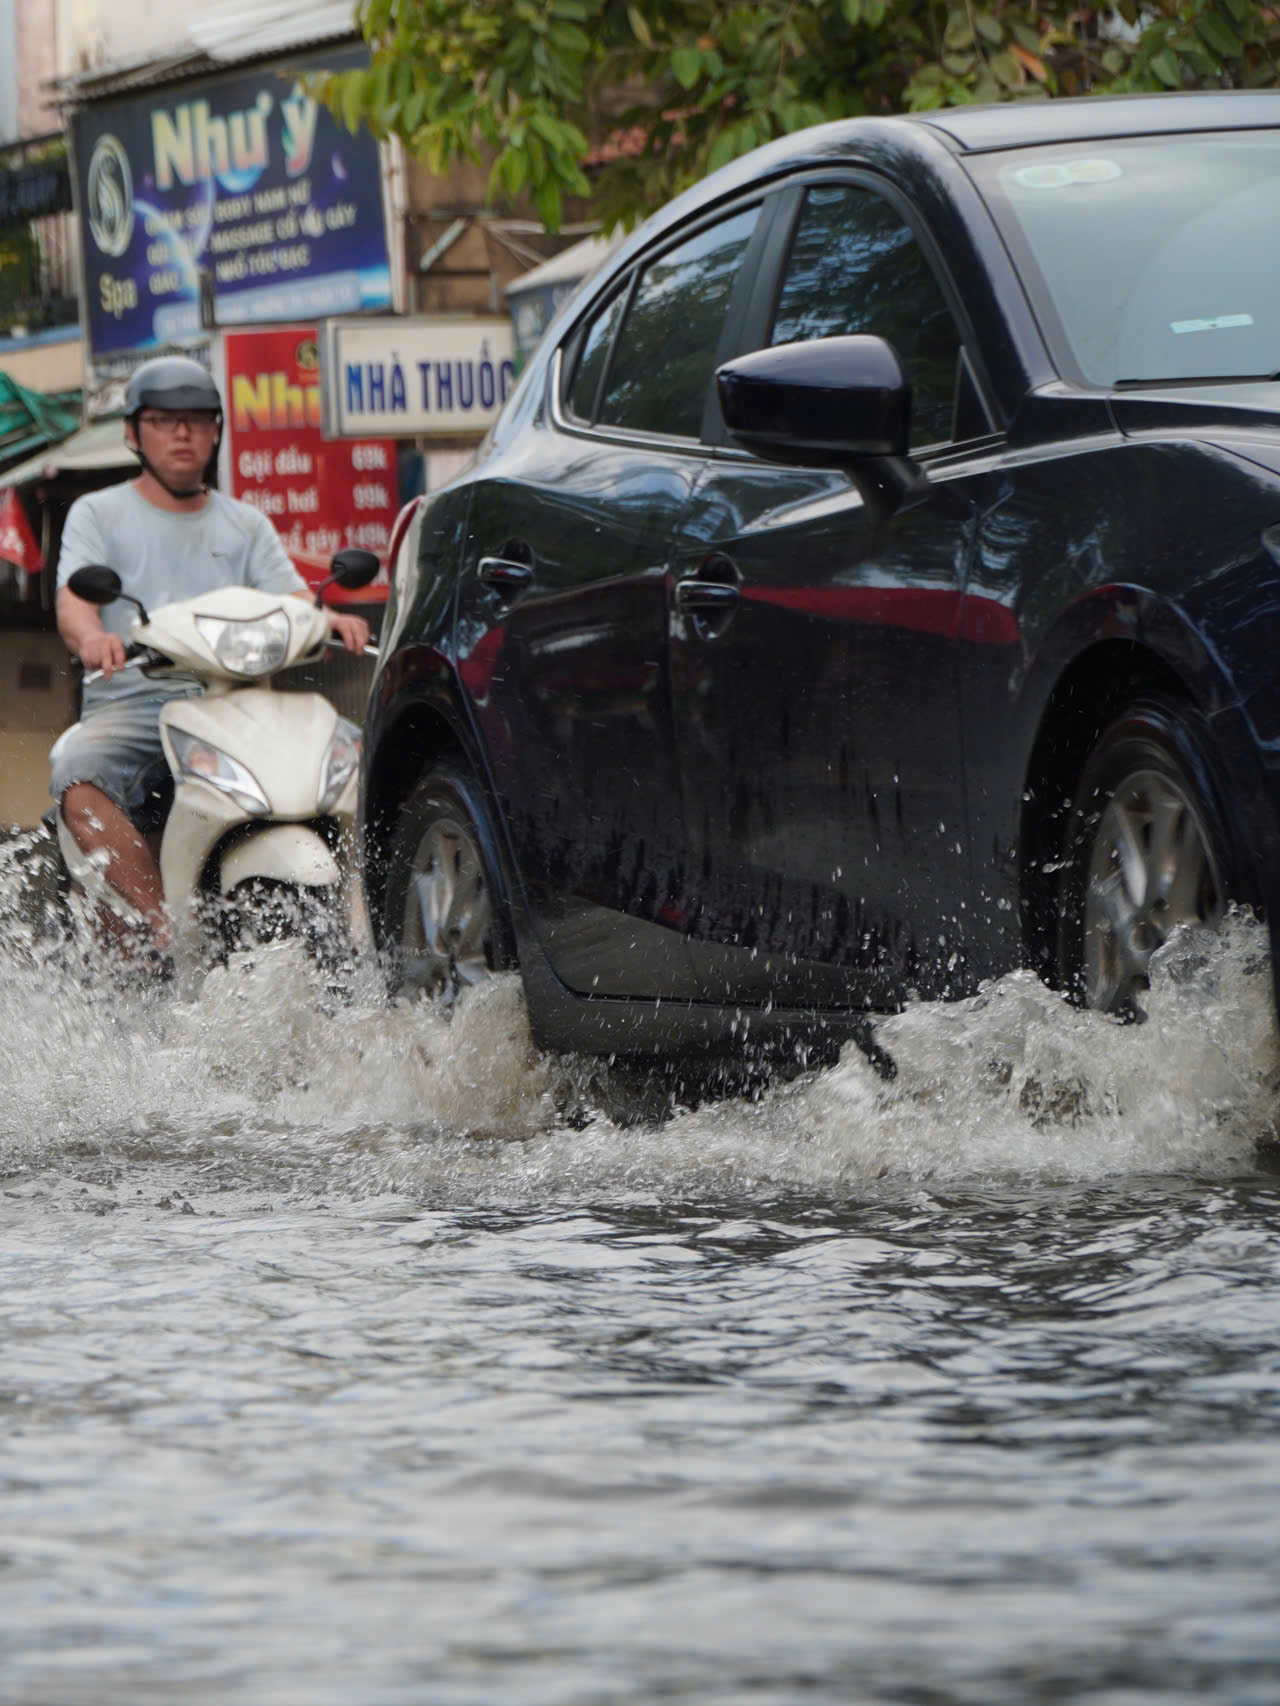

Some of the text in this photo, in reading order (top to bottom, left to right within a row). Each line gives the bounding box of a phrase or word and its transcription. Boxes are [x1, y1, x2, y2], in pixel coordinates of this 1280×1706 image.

[150, 90, 273, 190] Như
[215, 196, 252, 222] BODY
[253, 188, 287, 213] NAM
[287, 178, 312, 206] NỮ
[210, 221, 276, 254] MASSAGE
[99, 272, 138, 320] Spa
[345, 351, 409, 414] NHÀ
[238, 443, 387, 483] Gội đầu 69k
[287, 484, 320, 512] hơi
[352, 483, 389, 511] 99k
